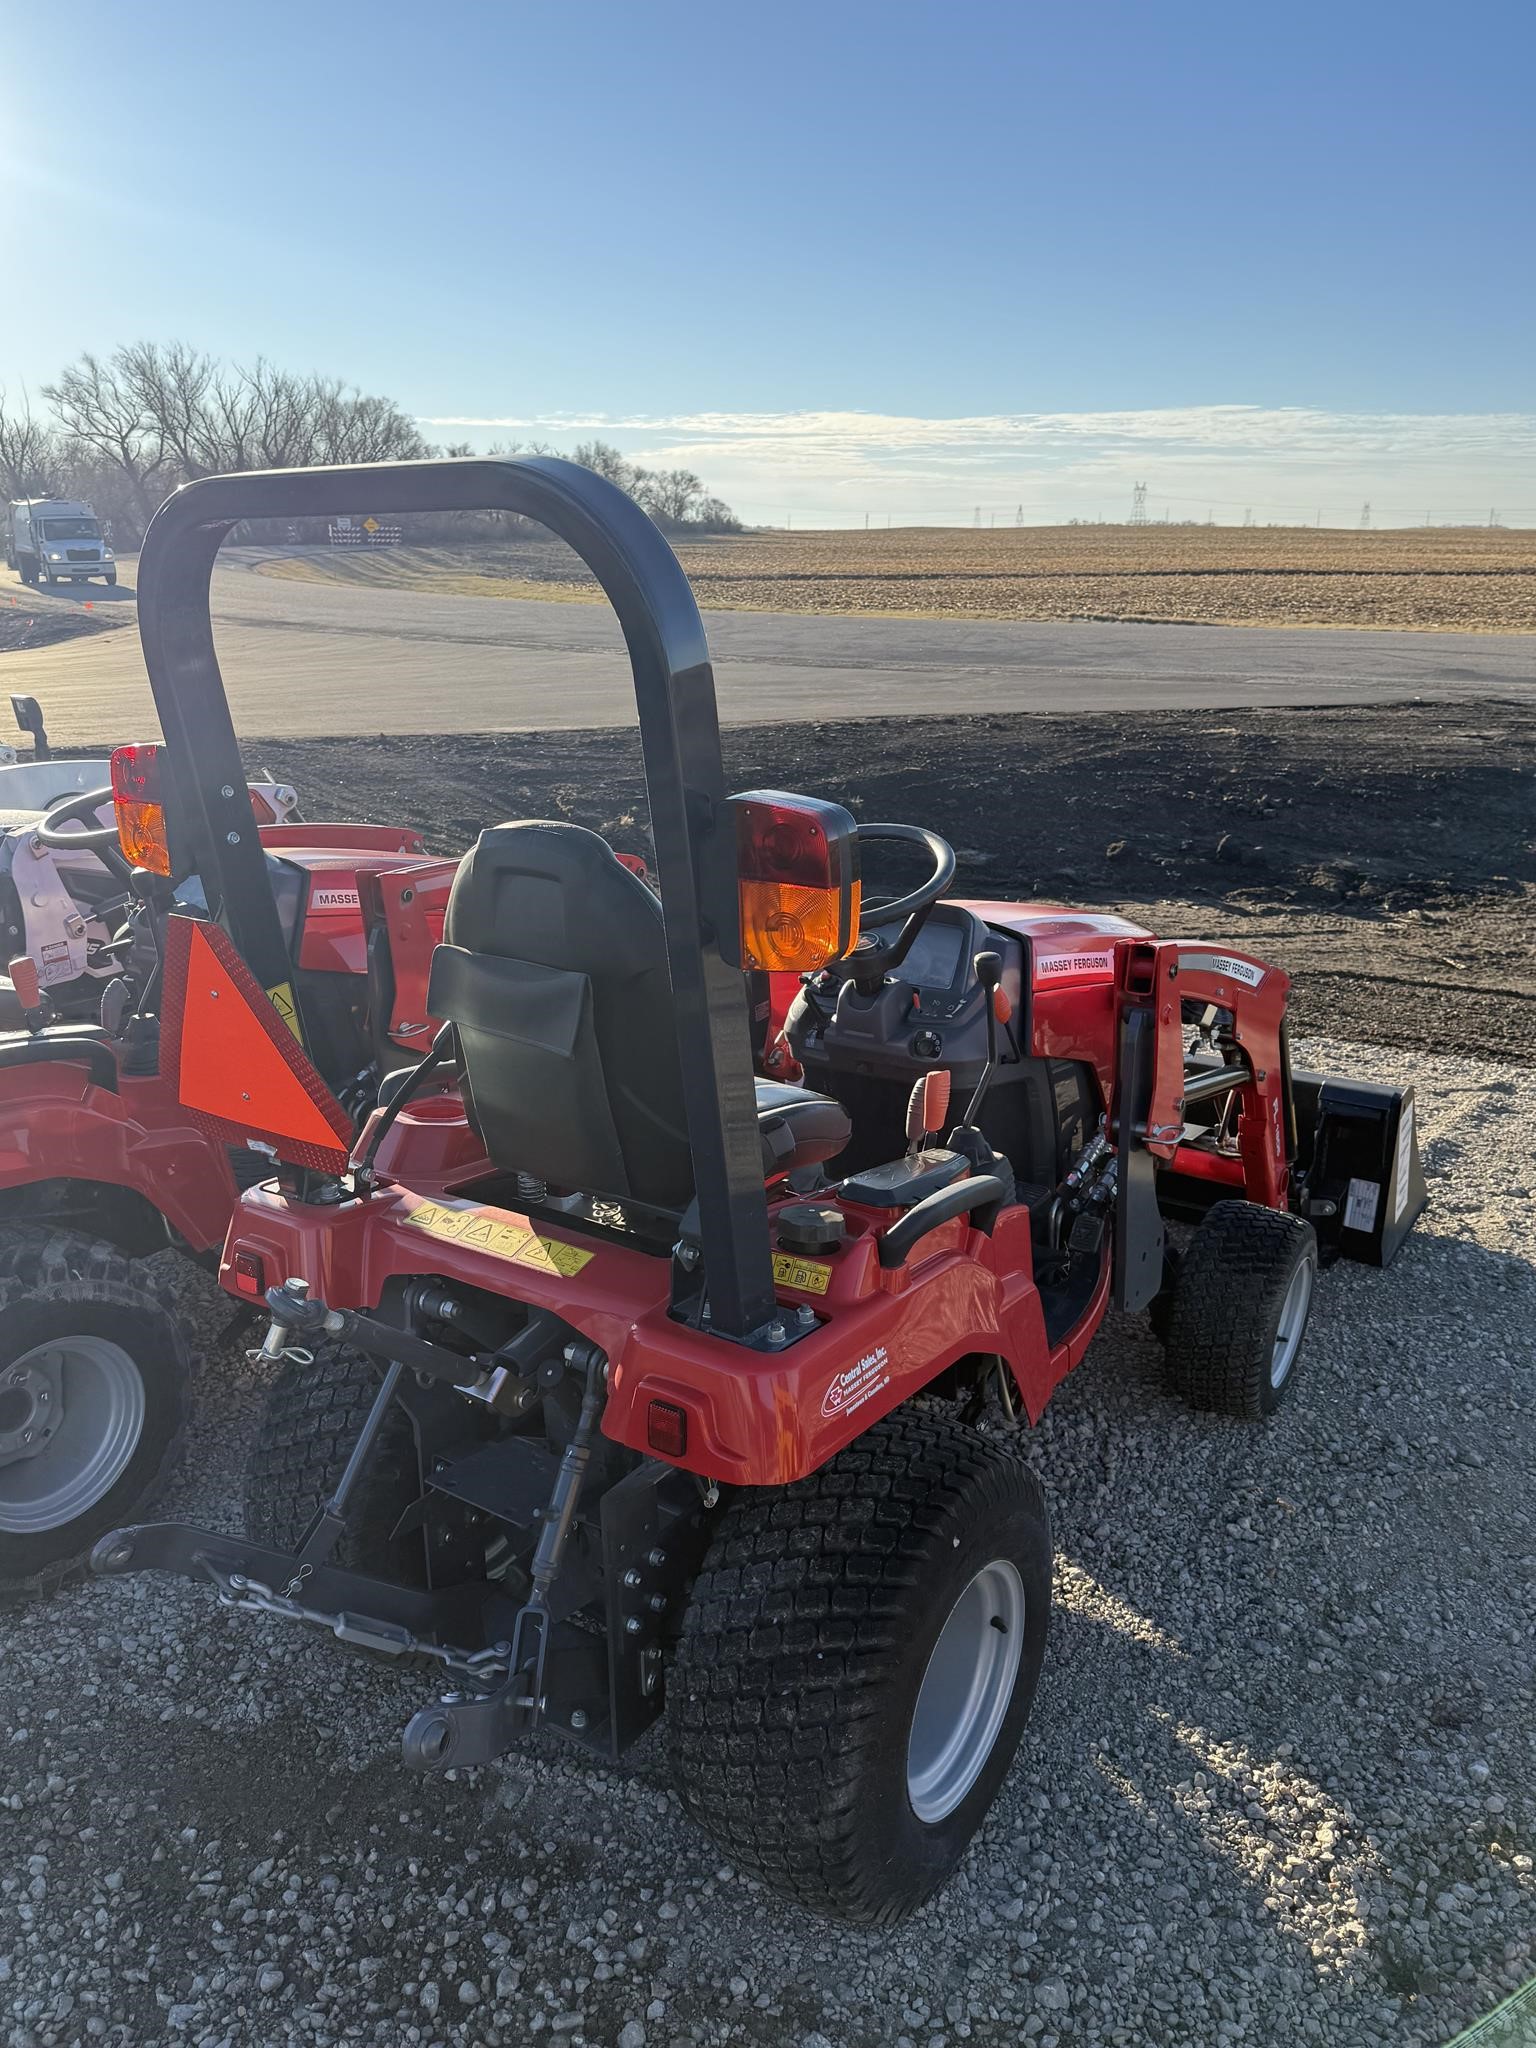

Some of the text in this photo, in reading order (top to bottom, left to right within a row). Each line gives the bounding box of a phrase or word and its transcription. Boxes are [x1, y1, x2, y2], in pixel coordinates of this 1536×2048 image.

[319, 894, 360, 905] MASSE
[1041, 957, 1108, 973] MASSEY FERGUSON
[1212, 958, 1255, 981] MASSEY FERGUSON
[840, 1361, 862, 1387] Central
[875, 1346, 887, 1360] Inc.
[844, 1357, 888, 1396] MASSEY FERGUSON
